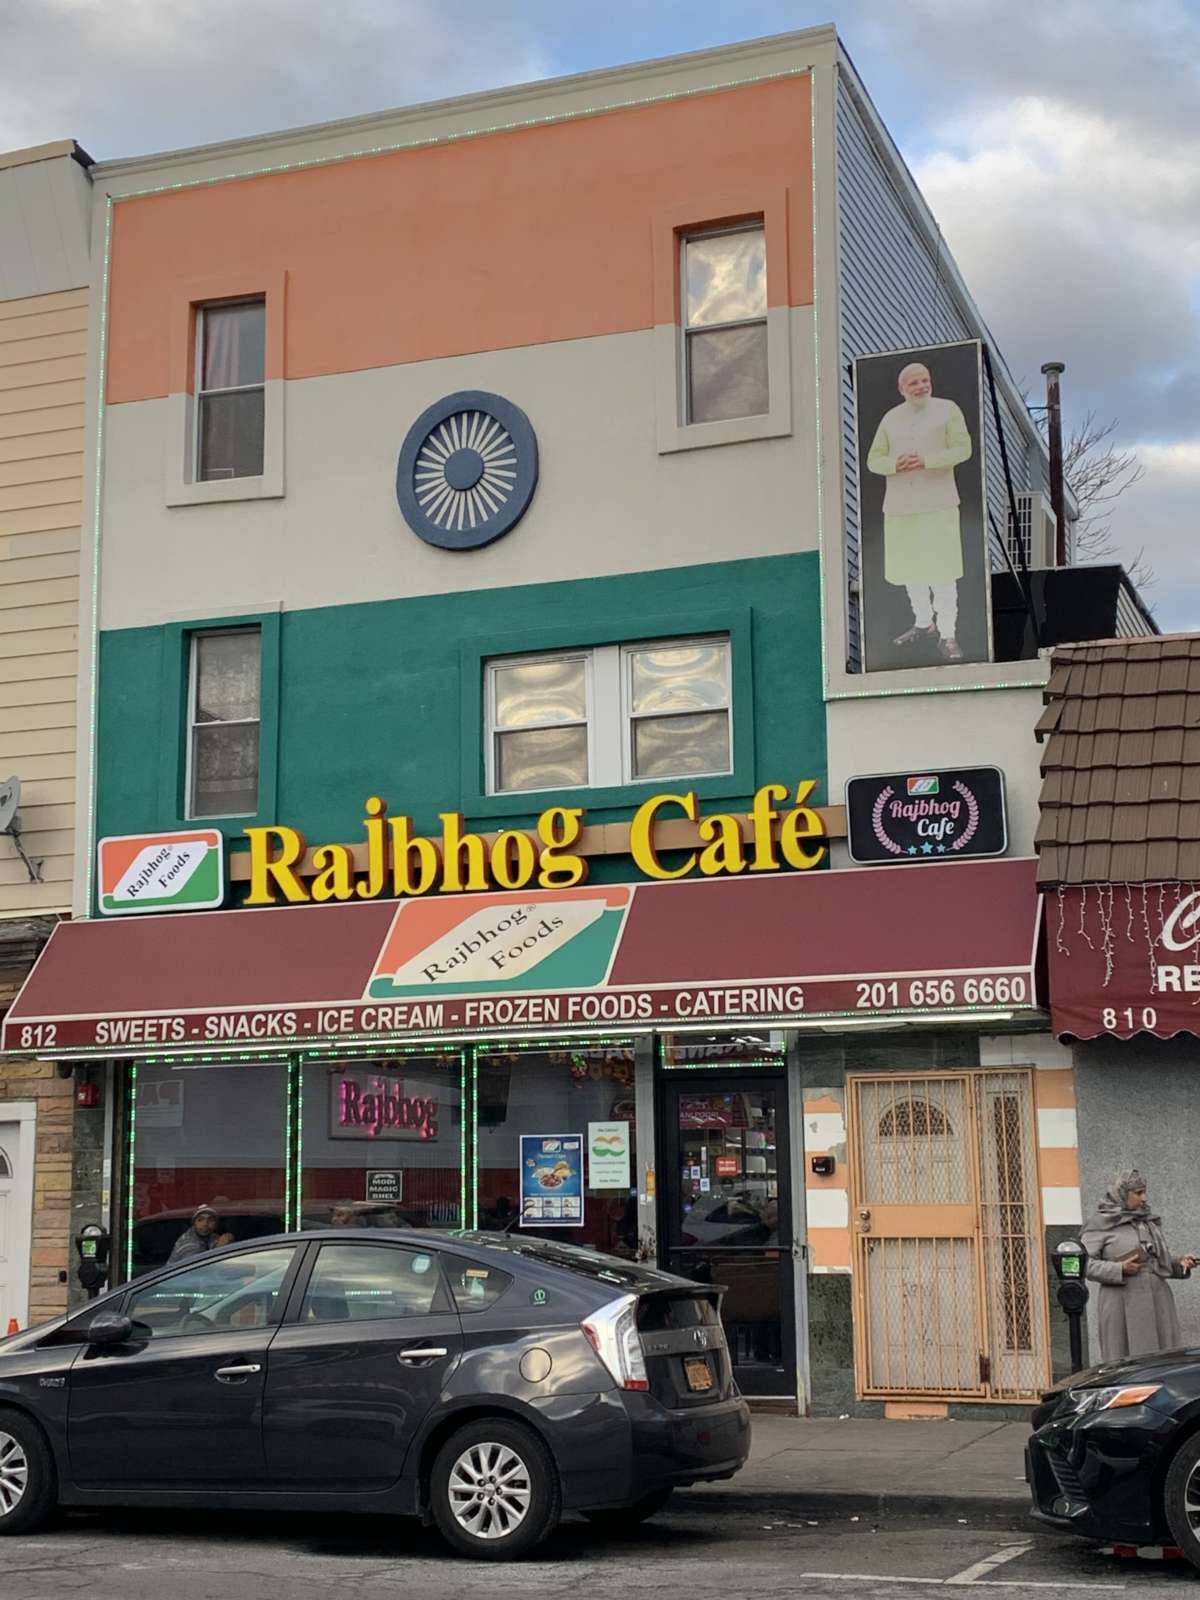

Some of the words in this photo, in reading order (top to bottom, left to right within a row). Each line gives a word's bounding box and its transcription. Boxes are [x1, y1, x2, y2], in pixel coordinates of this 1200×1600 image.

[889, 798, 961, 822] Rajbhog
[917, 817, 954, 840] Cafe
[243, 797, 588, 905] Rajbhog
[629, 780, 827, 879] Café
[126, 847, 171, 897] Rajbhog
[158, 851, 190, 888] Foods
[420, 906, 529, 982] Rajbhog
[488, 915, 564, 970] Foods
[856, 982, 899, 1008] 201
[909, 979, 955, 1005] 656
[963, 977, 1025, 1003] 6660
[21, 1024, 56, 1047] 812
[95, 1017, 185, 1044] SWEETS
[205, 1012, 297, 1039] SNACKS
[318, 1009, 354, 1033] ICE
[360, 1004, 443, 1030] CREAM
[465, 997, 560, 1025] FROZEN
[567, 993, 653, 1020] FOODS
[675, 985, 804, 1017] CATERING
